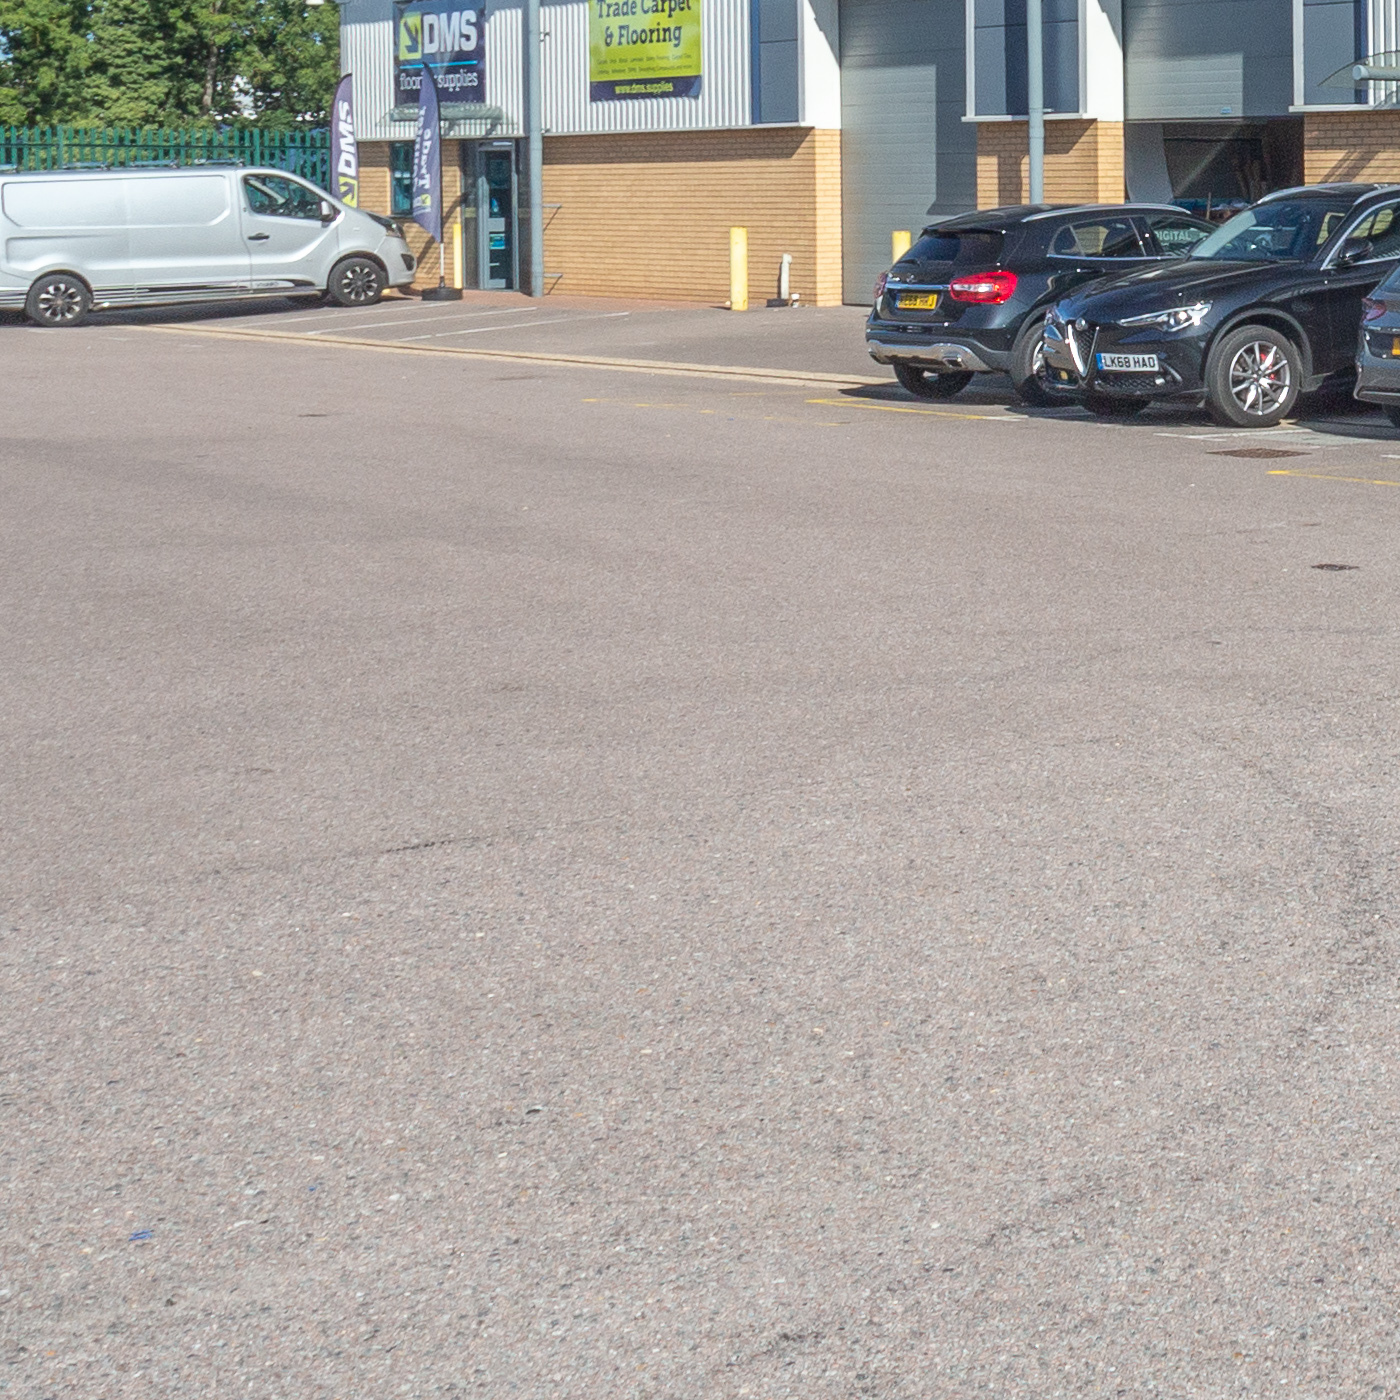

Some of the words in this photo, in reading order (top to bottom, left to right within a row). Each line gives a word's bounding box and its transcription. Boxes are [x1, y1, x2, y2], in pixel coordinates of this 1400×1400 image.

[423, 10, 478, 54] DMS
[605, 25, 614, 47] &
[617, 22, 682, 47] Flooring
[437, 69, 478, 92] supplies
[338, 100, 357, 177] DMS
[1104, 356, 1131, 368] LK68
